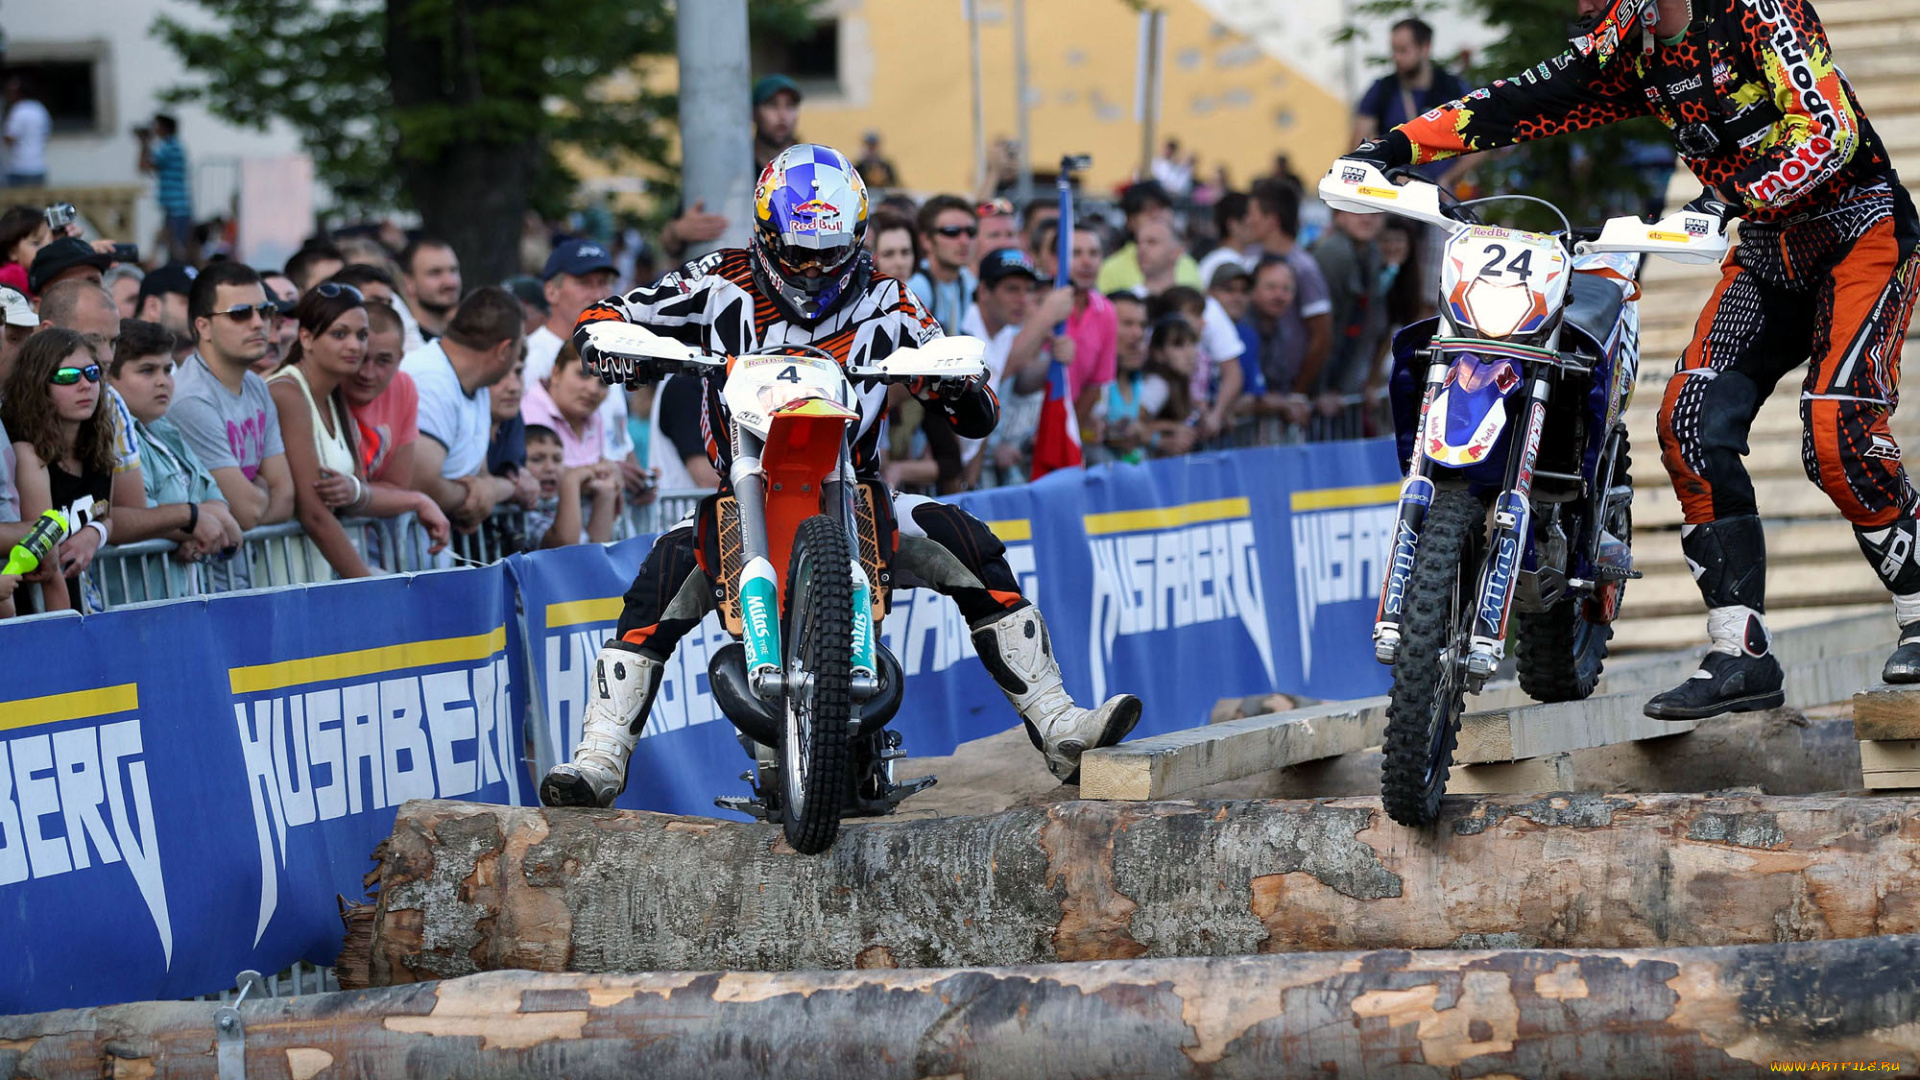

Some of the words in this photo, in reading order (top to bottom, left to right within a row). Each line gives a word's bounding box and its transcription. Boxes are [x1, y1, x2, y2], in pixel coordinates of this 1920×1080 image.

[1344, 167, 1365, 176] BAR
[790, 219, 816, 232] Red
[818, 219, 843, 231] Bull
[1473, 227, 1494, 237] Red
[1686, 219, 1708, 228] BAR
[1686, 225, 1708, 234] 2000
[1479, 243, 1533, 281] 24
[776, 365, 802, 384] 4
[1384, 519, 1419, 615] Mitas
[1480, 537, 1517, 634] Mitas
[746, 595, 770, 638] Mitas
[1089, 520, 1276, 711] HUSABERG
[234, 655, 521, 950] HUSABERG
